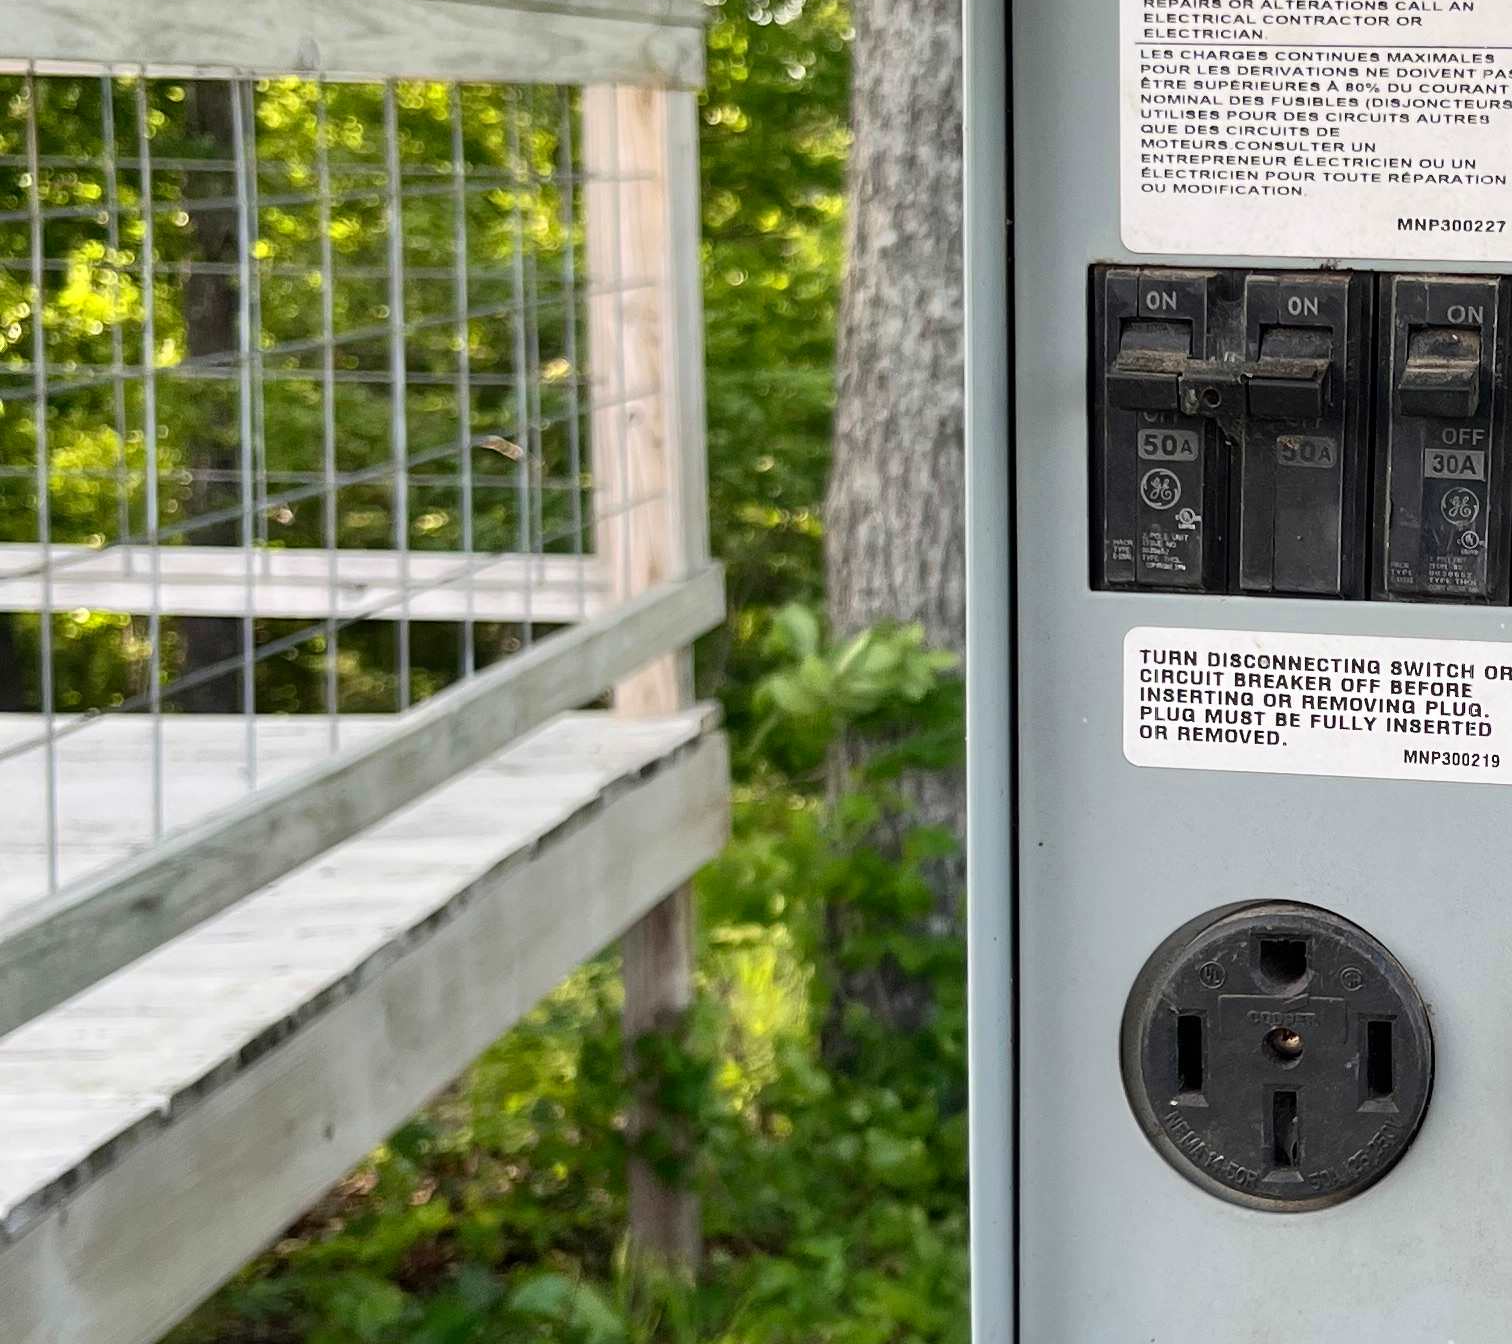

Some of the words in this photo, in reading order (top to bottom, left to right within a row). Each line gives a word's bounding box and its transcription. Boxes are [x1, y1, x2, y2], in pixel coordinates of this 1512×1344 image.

[1229, 0, 1253, 9] OR
[1261, 0, 1389, 10] ALTERATIONS
[1395, 1, 1443, 11] CALL
[1449, 1, 1474, 11] AN
[1144, 13, 1256, 24] ELECTRICAL
[1263, 15, 1389, 26] CONTRACTOR
[1396, 16, 1422, 26] OR
[1140, 50, 1173, 60] LES
[1181, 50, 1268, 61] CHARGES
[1275, 51, 1380, 62] CONTINUES
[1388, 53, 1494, 63] MAXIMALES
[1140, 65, 1190, 74] POUR
[1198, 65, 1230, 75] LES
[1367, 68, 1389, 77] NE
[1397, 69, 1476, 78] DOIVENT
[1346, 83, 1380, 93] 80%
[1388, 83, 1412, 93] DU
[1419, 84, 1509, 94] COURANT
[1140, 94, 1223, 105] NOMINAL
[1230, 96, 1264, 105] DES
[1271, 96, 1359, 107] FUSIBLES
[1140, 110, 1220, 119] UTILISES
[1227, 111, 1276, 120] POUR
[1284, 112, 1318, 121] DES
[1326, 113, 1410, 123] CIRCUITS
[1416, 114, 1489, 124] AUTRES
[1140, 125, 1178, 134] QUE
[1185, 125, 1219, 135] DES
[1226, 126, 1309, 136] CIRCUITS
[1317, 128, 1340, 137] DE
[1235, 141, 1345, 152] CONSULTER
[1352, 142, 1376, 152] UN
[1141, 154, 1286, 166] ENTREPRENEUR
[1419, 159, 1444, 169] OU
[1452, 159, 1476, 169] UN
[1141, 167, 1258, 180] ÉLECTRICIEN
[1266, 171, 1315, 181] POUR
[1323, 173, 1382, 182] TOUTE
[1388, 172, 1507, 184] RÉPARATION
[1141, 183, 1166, 193] OU
[1397, 218, 1506, 234] MNP300227
[1146, 291, 1177, 310] ON
[1288, 296, 1318, 316] ON
[1446, 305, 1484, 324] ON
[1143, 434, 1193, 456] 50A
[1442, 428, 1485, 446] OFF
[1432, 454, 1476, 475] 30A
[1140, 650, 1197, 666] TURN
[1208, 652, 1380, 674] DISCONNECTING
[1391, 661, 1474, 678] SWITCH
[1485, 666, 1512, 681] OR
[1140, 669, 1224, 686] CIRCUIT
[1234, 673, 1331, 691] BREAKER
[1341, 678, 1380, 693] OFF
[1391, 680, 1473, 698] BEFORE
[1140, 687, 1253, 706] INSERTING
[1264, 694, 1291, 708] OR
[1302, 695, 1415, 714] REMOVING
[1426, 701, 1489, 718] PLUG.
[1140, 706, 1195, 722] PLUG
[1205, 709, 1265, 726] MUST
[1276, 712, 1300, 727] BE
[1311, 714, 1377, 731] FULLY
[1386, 718, 1492, 737] INSERTED
[1140, 725, 1167, 740] OR
[1178, 726, 1286, 746] REMOVED.
[1404, 749, 1500, 767] MNP300219
